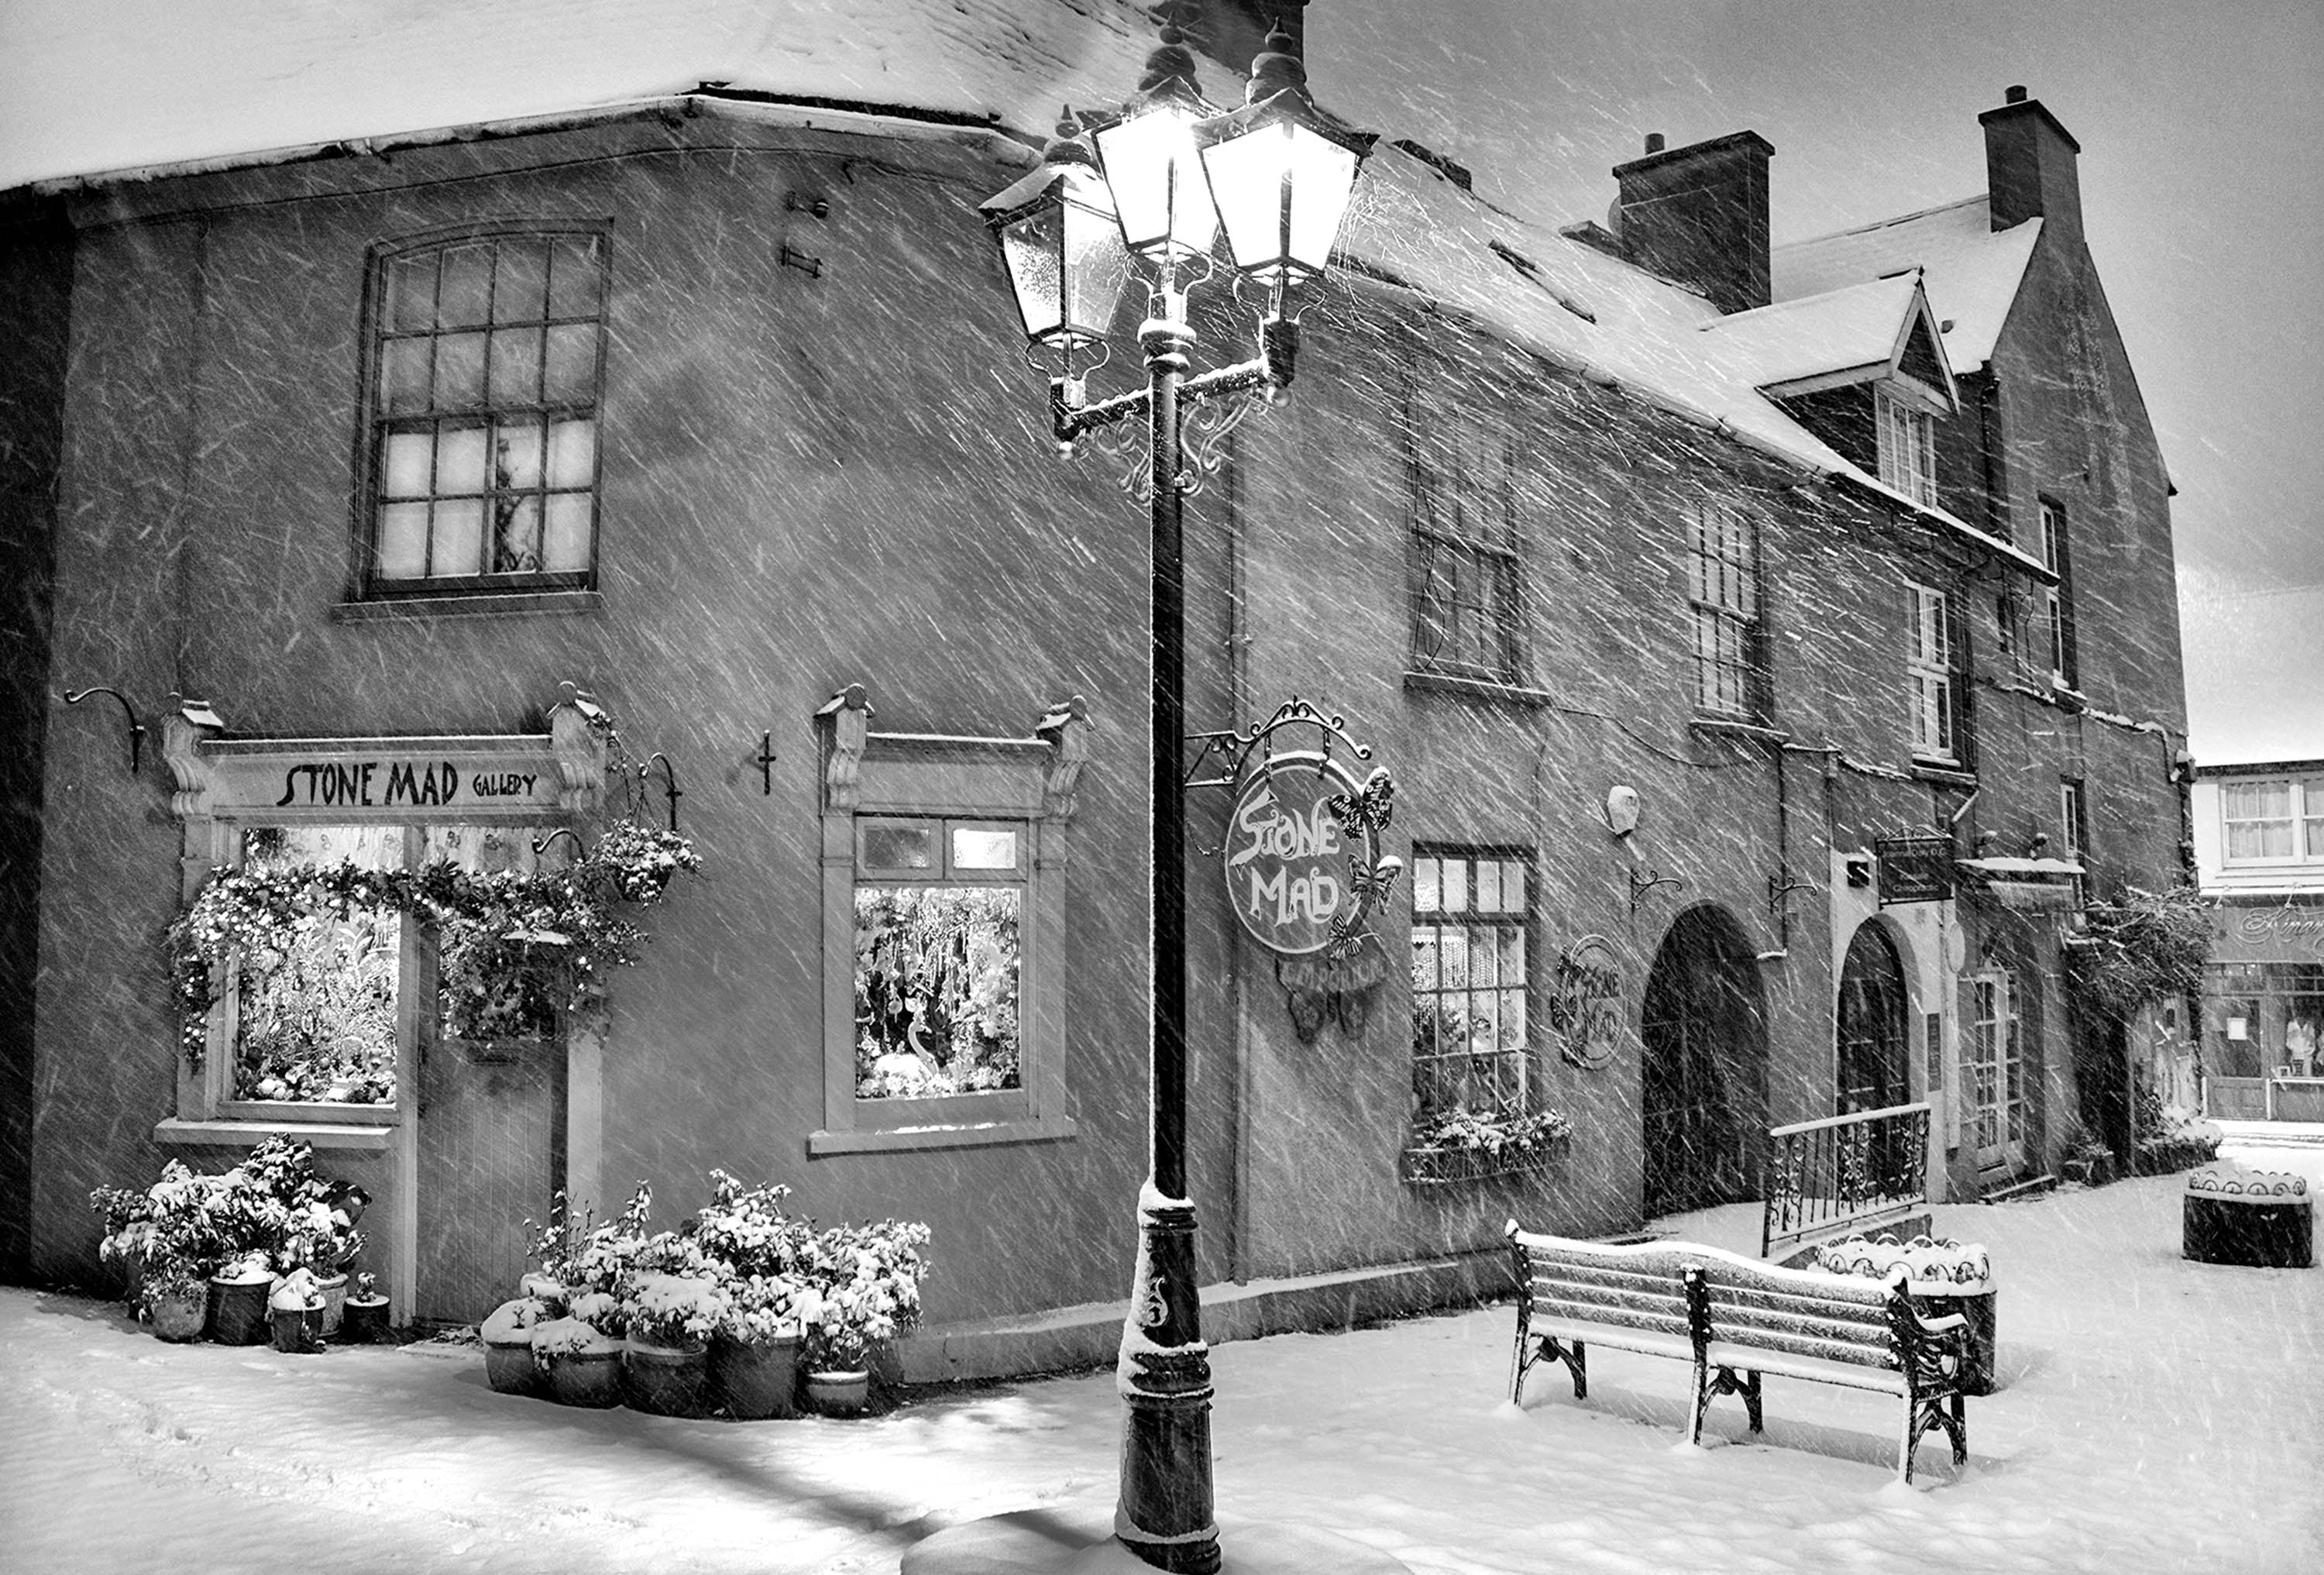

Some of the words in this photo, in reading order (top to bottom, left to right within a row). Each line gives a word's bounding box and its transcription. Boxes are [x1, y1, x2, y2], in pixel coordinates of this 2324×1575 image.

[275, 762, 378, 806] STONE
[384, 762, 459, 806] MAD
[472, 773, 538, 797] GALLERY
[1229, 785, 1340, 881] STONE
[1248, 864, 1339, 928] MAD
